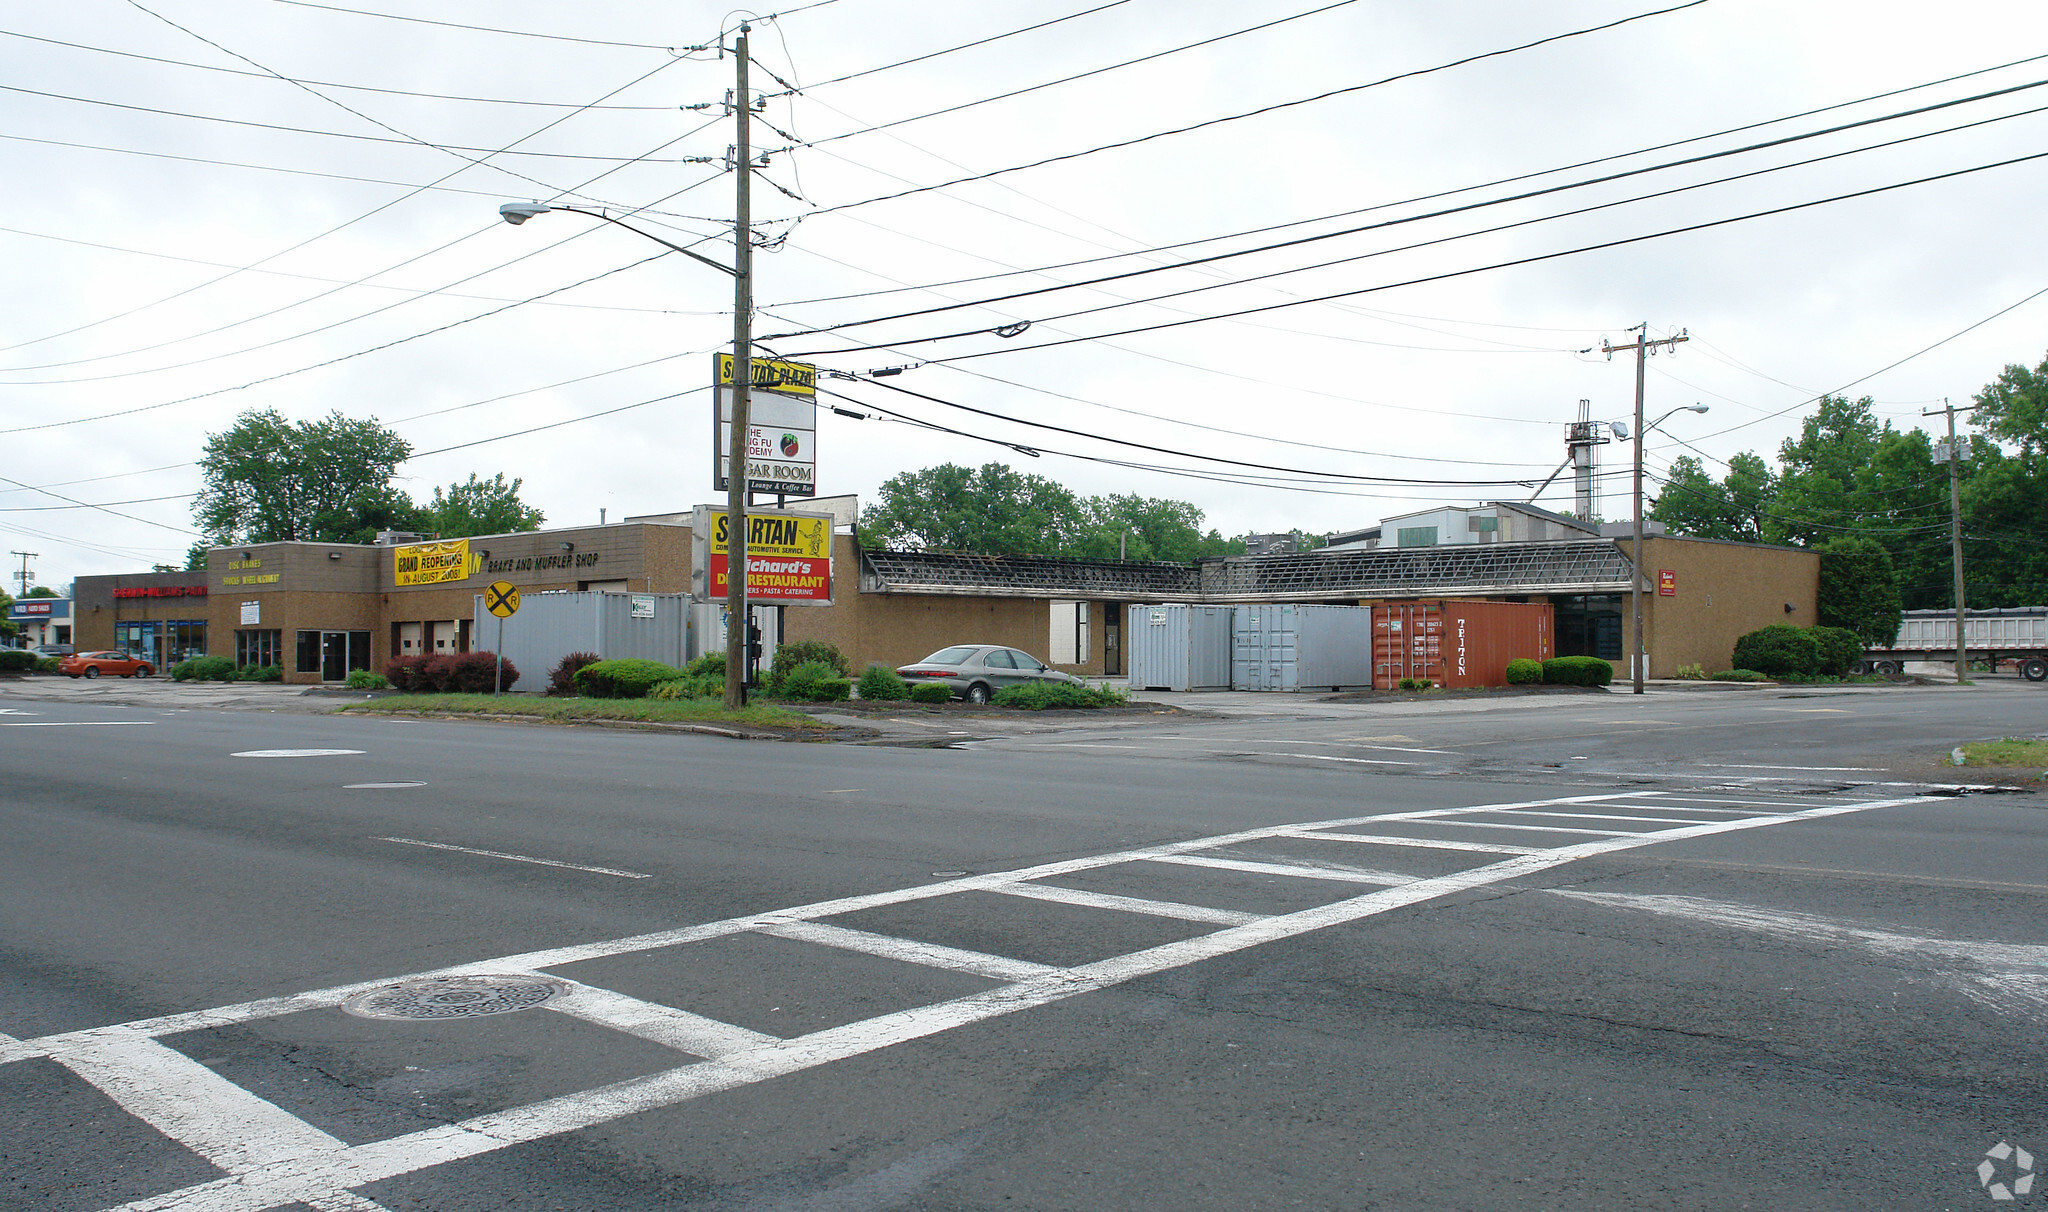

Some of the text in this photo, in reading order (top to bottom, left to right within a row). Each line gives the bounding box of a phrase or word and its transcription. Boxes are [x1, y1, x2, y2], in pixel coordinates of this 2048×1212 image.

[750, 429, 761, 437] HE
[761, 439, 772, 447] FU
[749, 447, 772, 456] DEMY
[747, 463, 811, 481] GAR ROOM
[781, 483, 800, 491] Coffee
[716, 515, 798, 546] SRTAN
[398, 556, 418, 572] GRAND
[421, 553, 462, 569] REOPENING
[488, 559, 513, 573] BRAKE
[515, 558, 532, 571] AND
[535, 555, 572, 570] MUFFLER
[576, 553, 598, 567] SHOP
[747, 559, 811, 574] ichard's
[403, 575, 411, 583] IN
[412, 572, 439, 582] AUGUST
[748, 574, 824, 587] RESTAURANT
[487, 594, 517, 605] R R
[1457, 618, 1466, 675] TRITON
